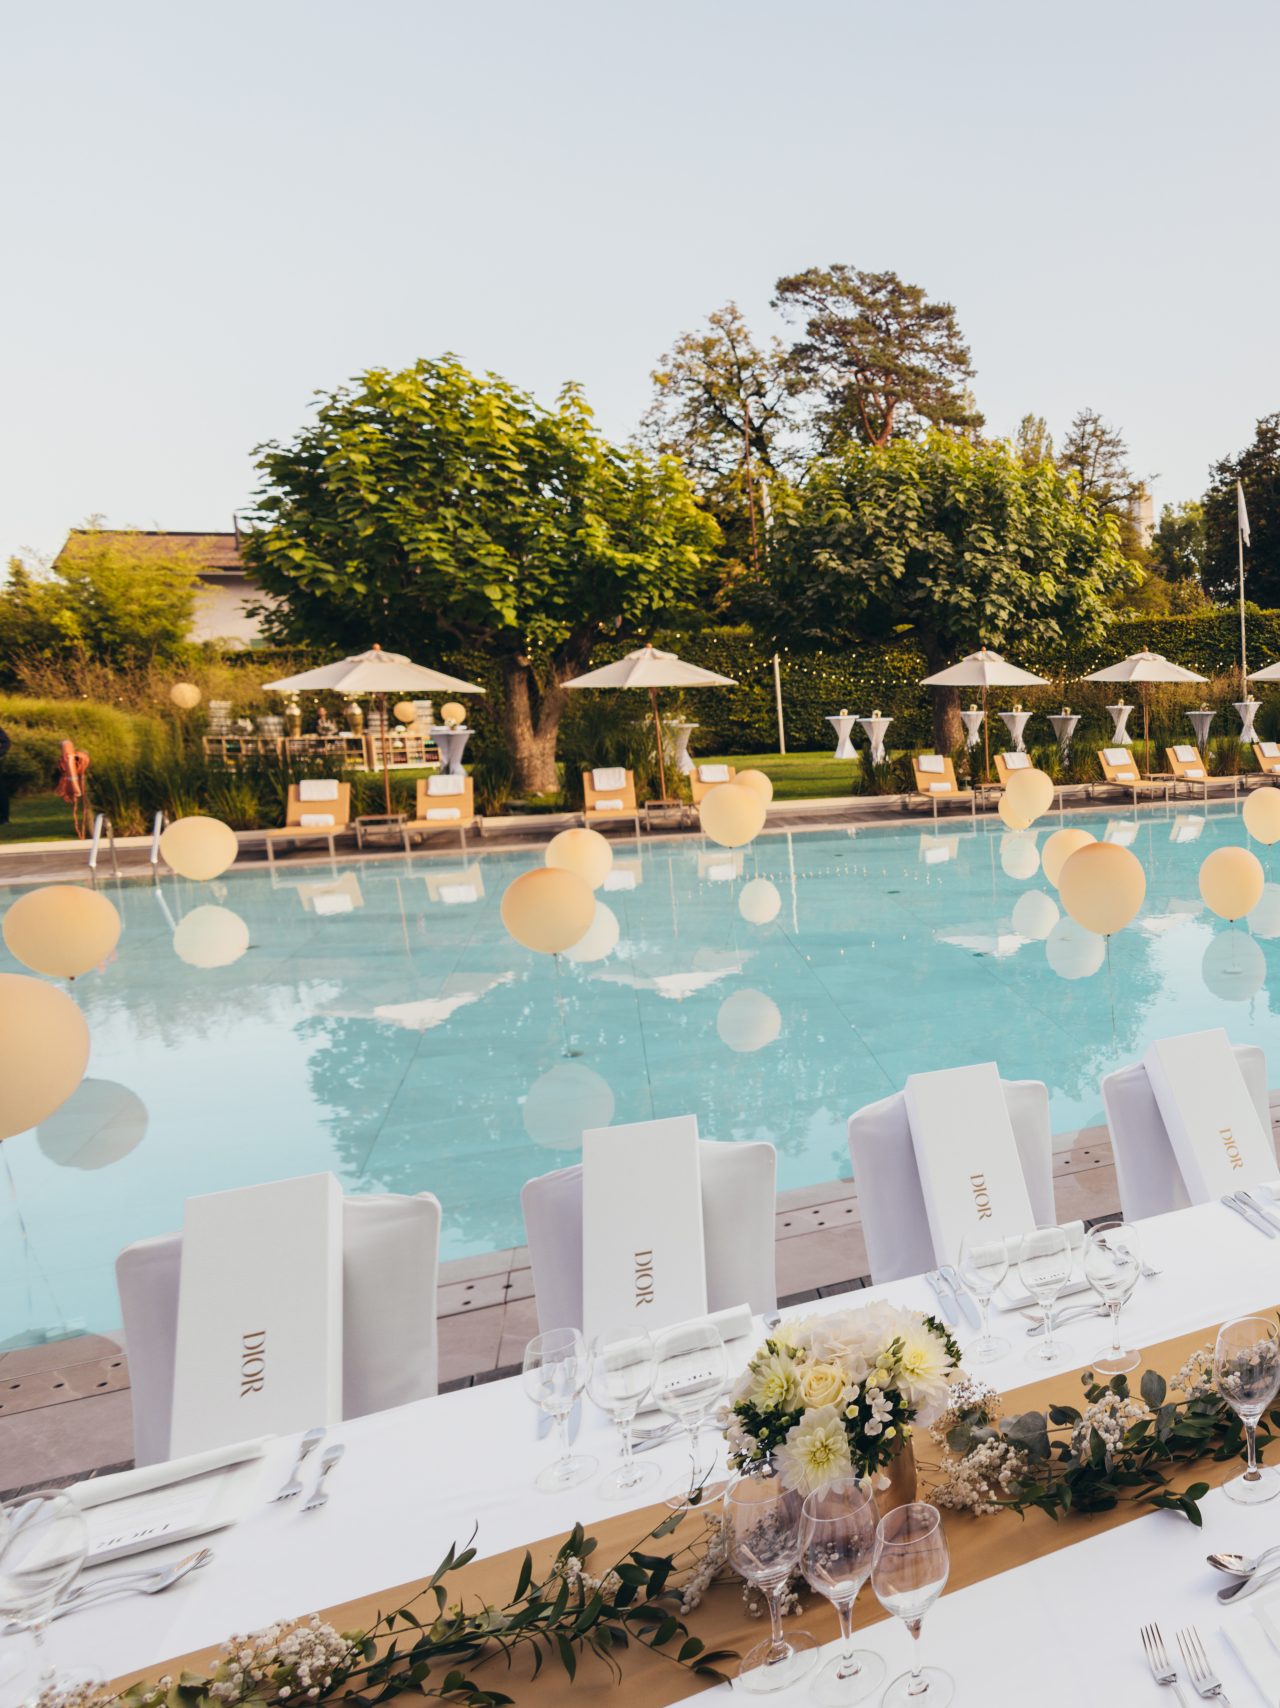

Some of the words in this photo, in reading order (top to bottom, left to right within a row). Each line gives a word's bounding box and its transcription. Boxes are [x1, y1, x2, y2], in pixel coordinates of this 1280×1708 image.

[1219, 1128, 1243, 1171] DIOR
[970, 1173, 992, 1222] DIOR
[635, 1249, 654, 1308] DIOR
[240, 1330, 266, 1399] DIOR
